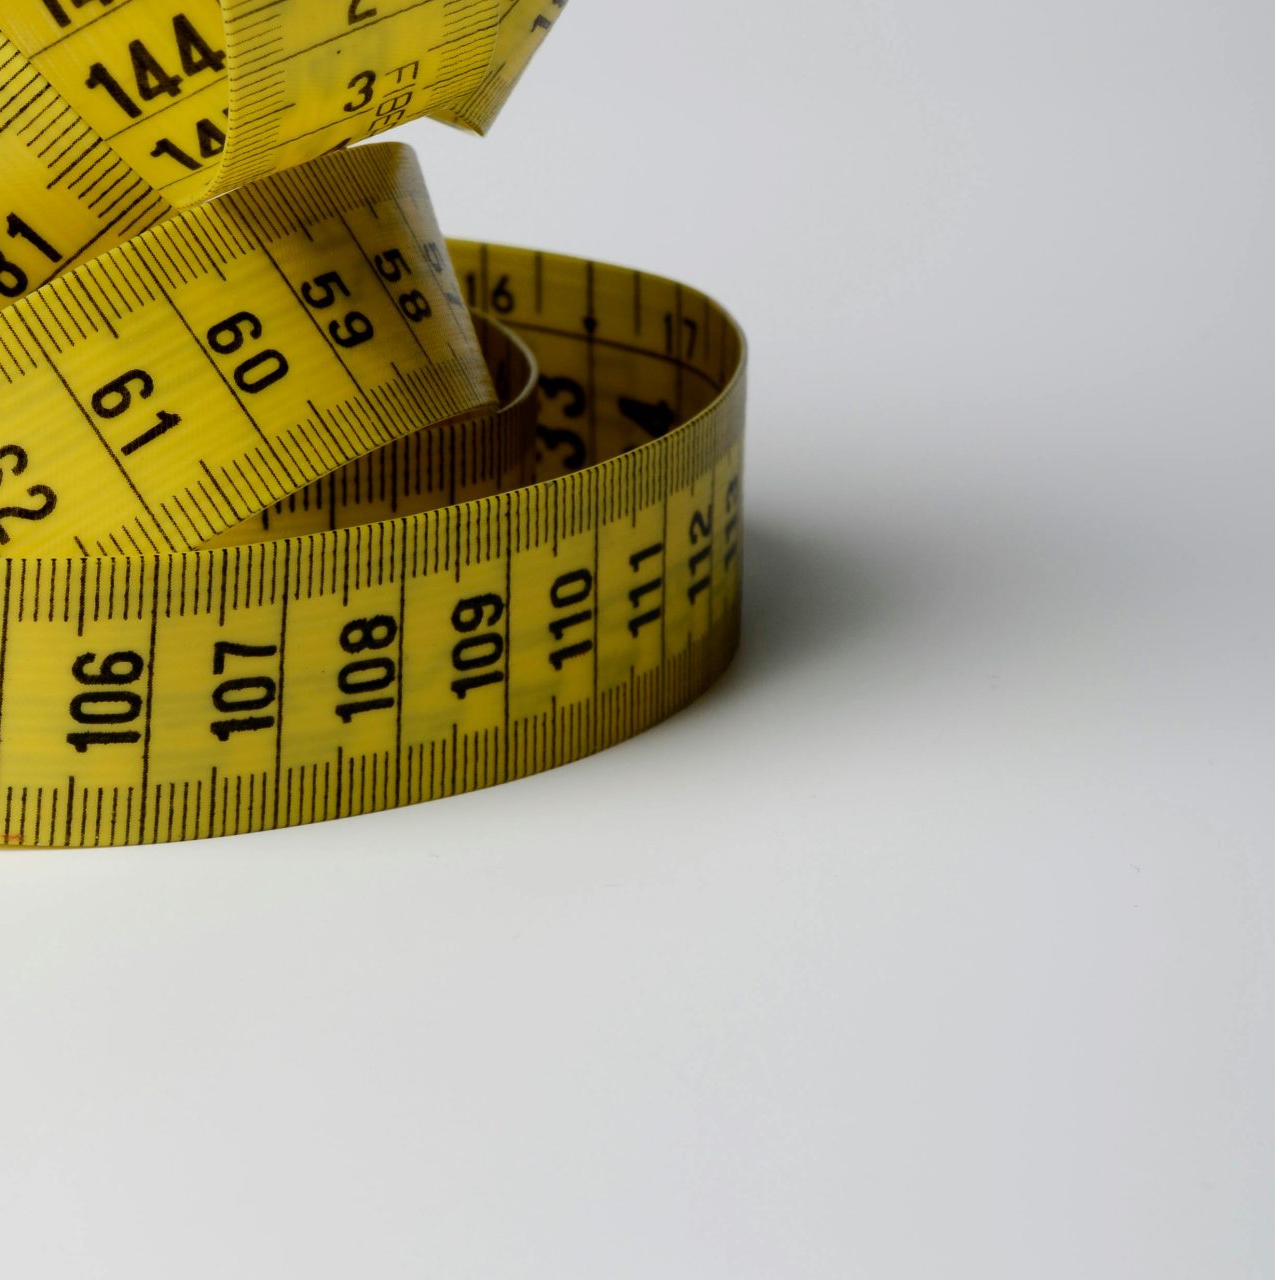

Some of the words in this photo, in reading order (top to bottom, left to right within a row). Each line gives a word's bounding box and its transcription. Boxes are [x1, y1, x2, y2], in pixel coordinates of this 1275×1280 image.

[86, 13, 227, 119] 144
[343, 70, 376, 112] 3
[150, 108, 229, 171] 14
[301, 271, 374, 348] 59
[375, 248, 432, 323] 58
[465, 273, 515, 315] 16
[207, 311, 290, 394] 60
[91, 369, 183, 456] 61
[627, 542, 664, 638] 111
[688, 504, 713, 606] 112
[450, 592, 505, 699] 109
[548, 568, 594, 671] 110
[66, 650, 144, 753] 106
[210, 641, 278, 741] 107
[335, 614, 398, 724] 108
